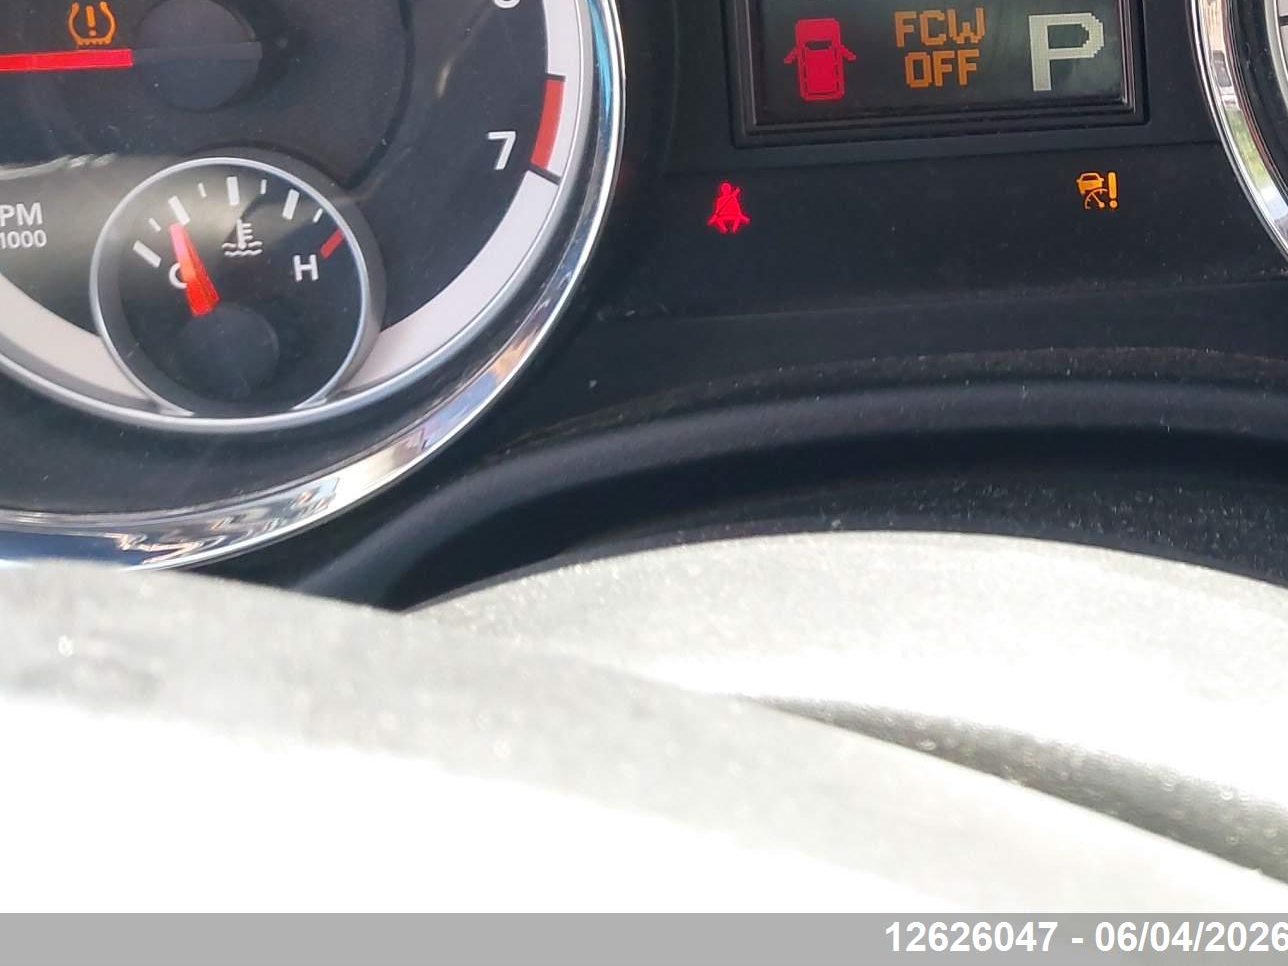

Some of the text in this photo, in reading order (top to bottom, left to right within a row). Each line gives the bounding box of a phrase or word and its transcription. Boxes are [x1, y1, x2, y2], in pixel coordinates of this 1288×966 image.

[894, 7, 985, 47] FCW
[904, 49, 980, 88] OFF
[1028, 12, 1104, 92] P
[487, 131, 517, 171] 7
[294, 255, 319, 281] H
